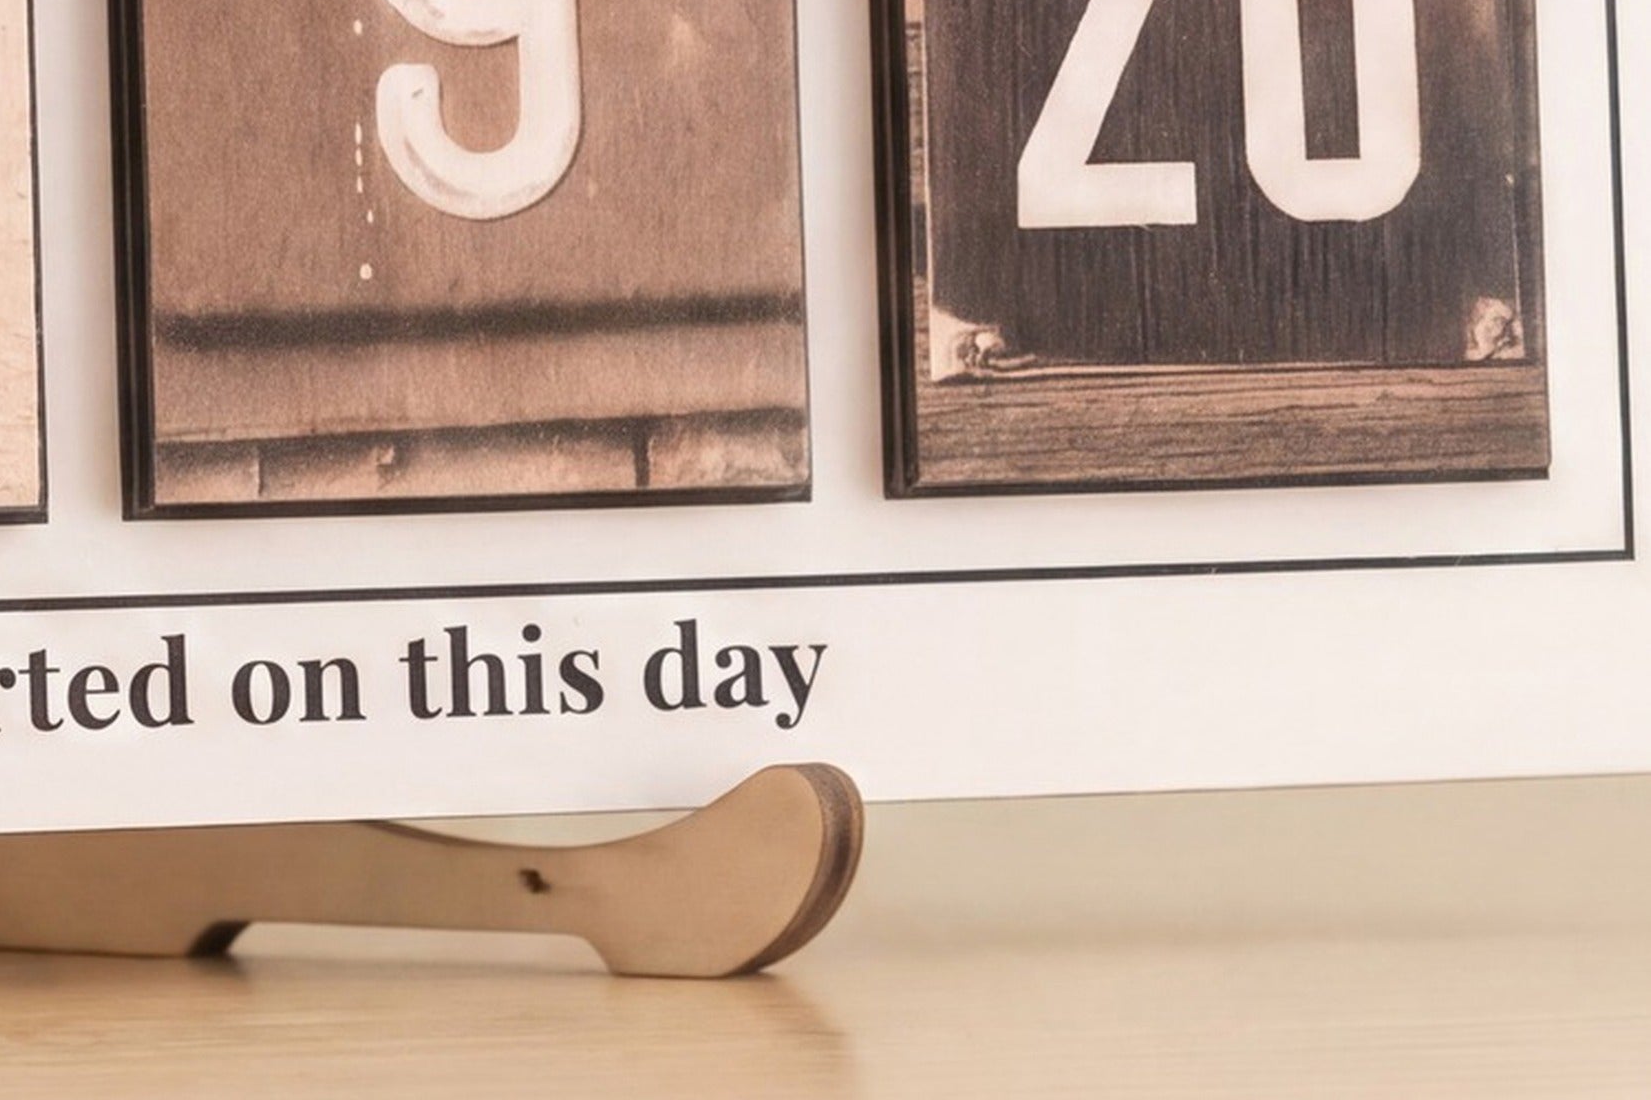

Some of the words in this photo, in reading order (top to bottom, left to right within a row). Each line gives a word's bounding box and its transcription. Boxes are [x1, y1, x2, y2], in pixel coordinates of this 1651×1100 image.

[231, 658, 366, 725] on
[399, 624, 604, 720] this
[643, 619, 827, 730] day
